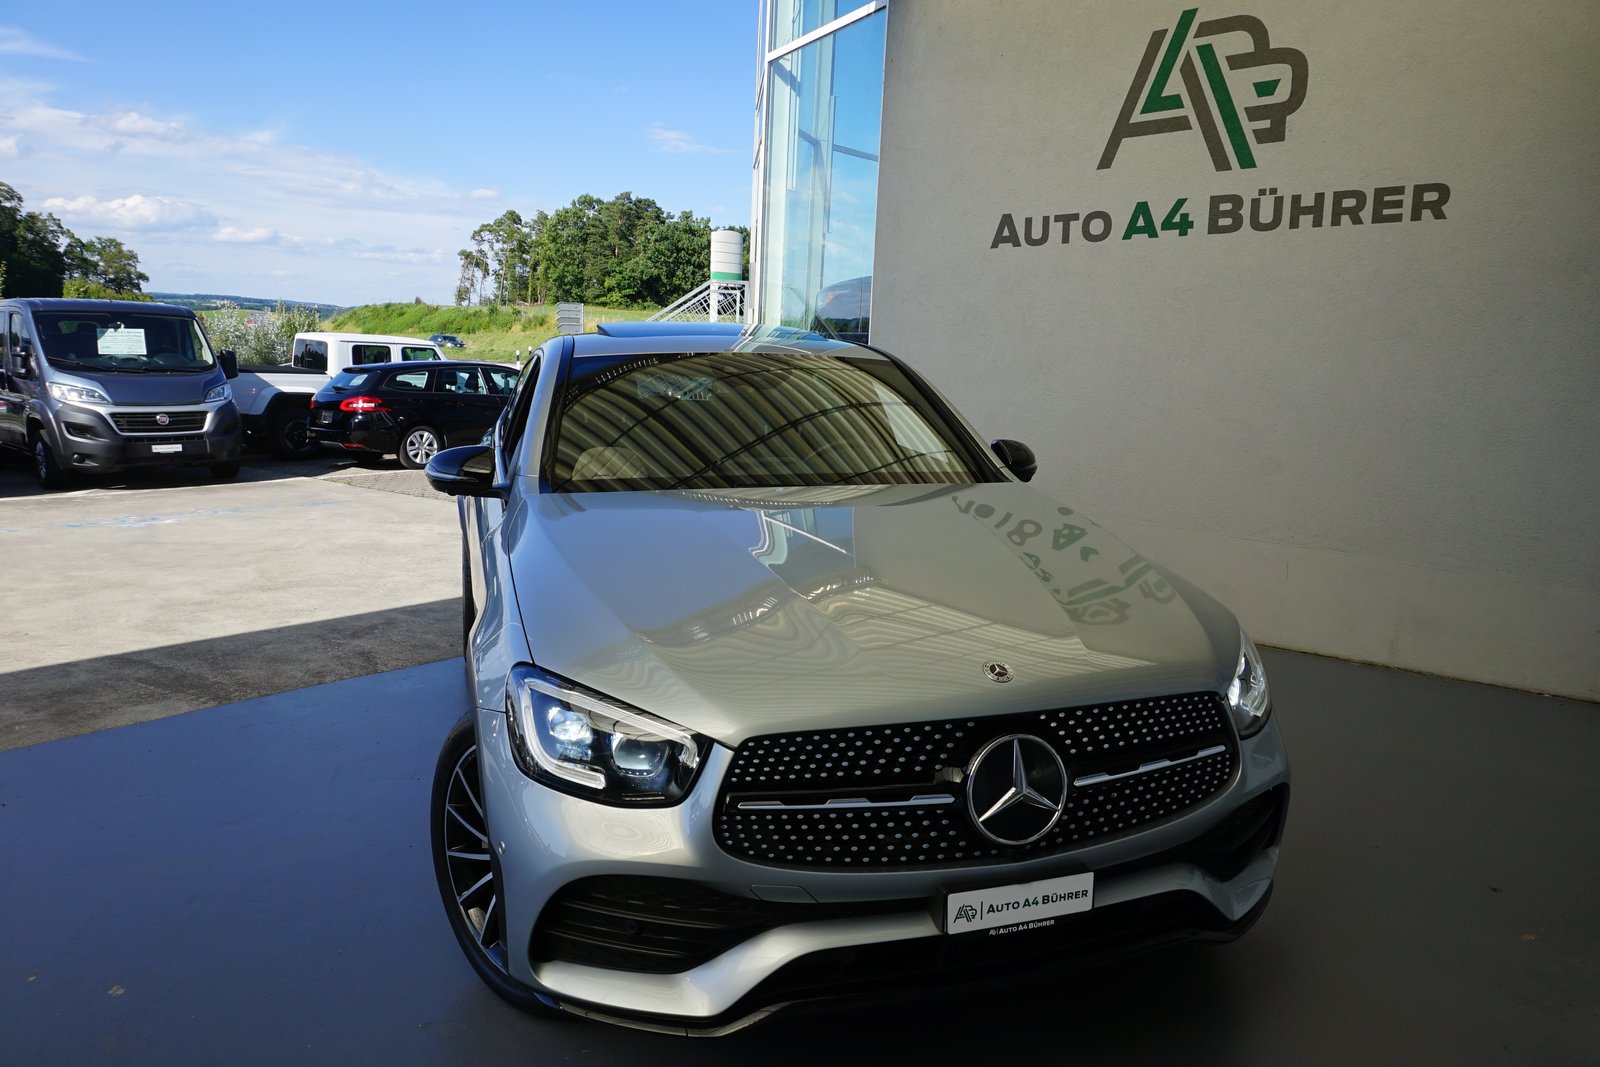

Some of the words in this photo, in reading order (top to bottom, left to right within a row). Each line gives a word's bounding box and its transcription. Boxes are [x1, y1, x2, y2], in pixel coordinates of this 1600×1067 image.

[990, 210, 1113, 249] AUTO
[1121, 197, 1195, 241] A4
[1207, 182, 1452, 236] BÜHRER
[986, 901, 1020, 915] AUTO
[1022, 896, 1040, 909] A4
[1041, 889, 1089, 905] BÜHRER
[999, 926, 1018, 935] AUTO
[1018, 923, 1028, 931] A4
[1028, 919, 1056, 929] BÜHRER
